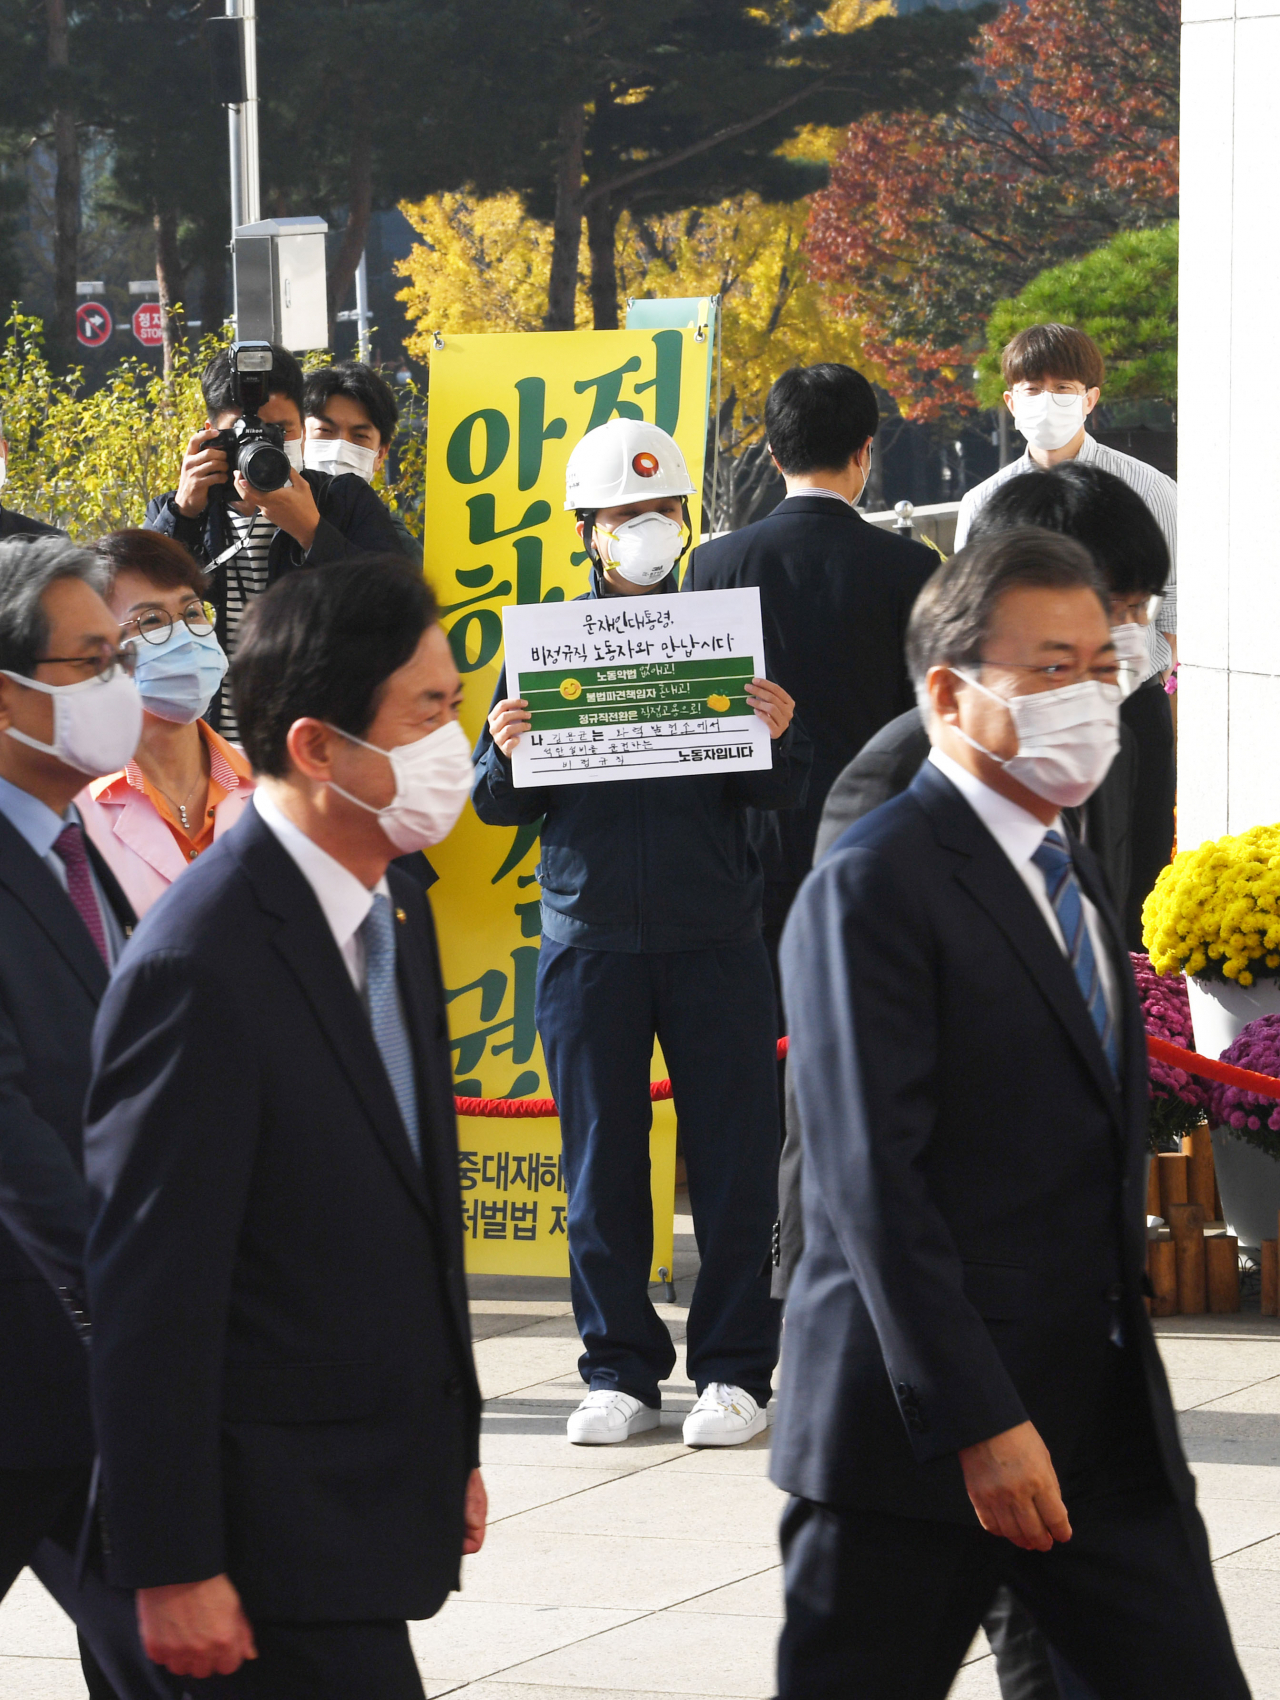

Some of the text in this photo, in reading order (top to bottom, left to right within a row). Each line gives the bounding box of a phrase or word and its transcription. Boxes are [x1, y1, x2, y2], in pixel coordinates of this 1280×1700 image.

[531, 633, 735, 666] 비정규직 노동자와 만납시다
[596, 663, 675, 682] 노동악법 없애고!
[586, 688, 657, 703] 불법파견책임자
[579, 703, 701, 725] 정규직전환은 직접고용으로!
[531, 734, 543, 746] 나
[678, 746, 754, 762] 노동자입니다
